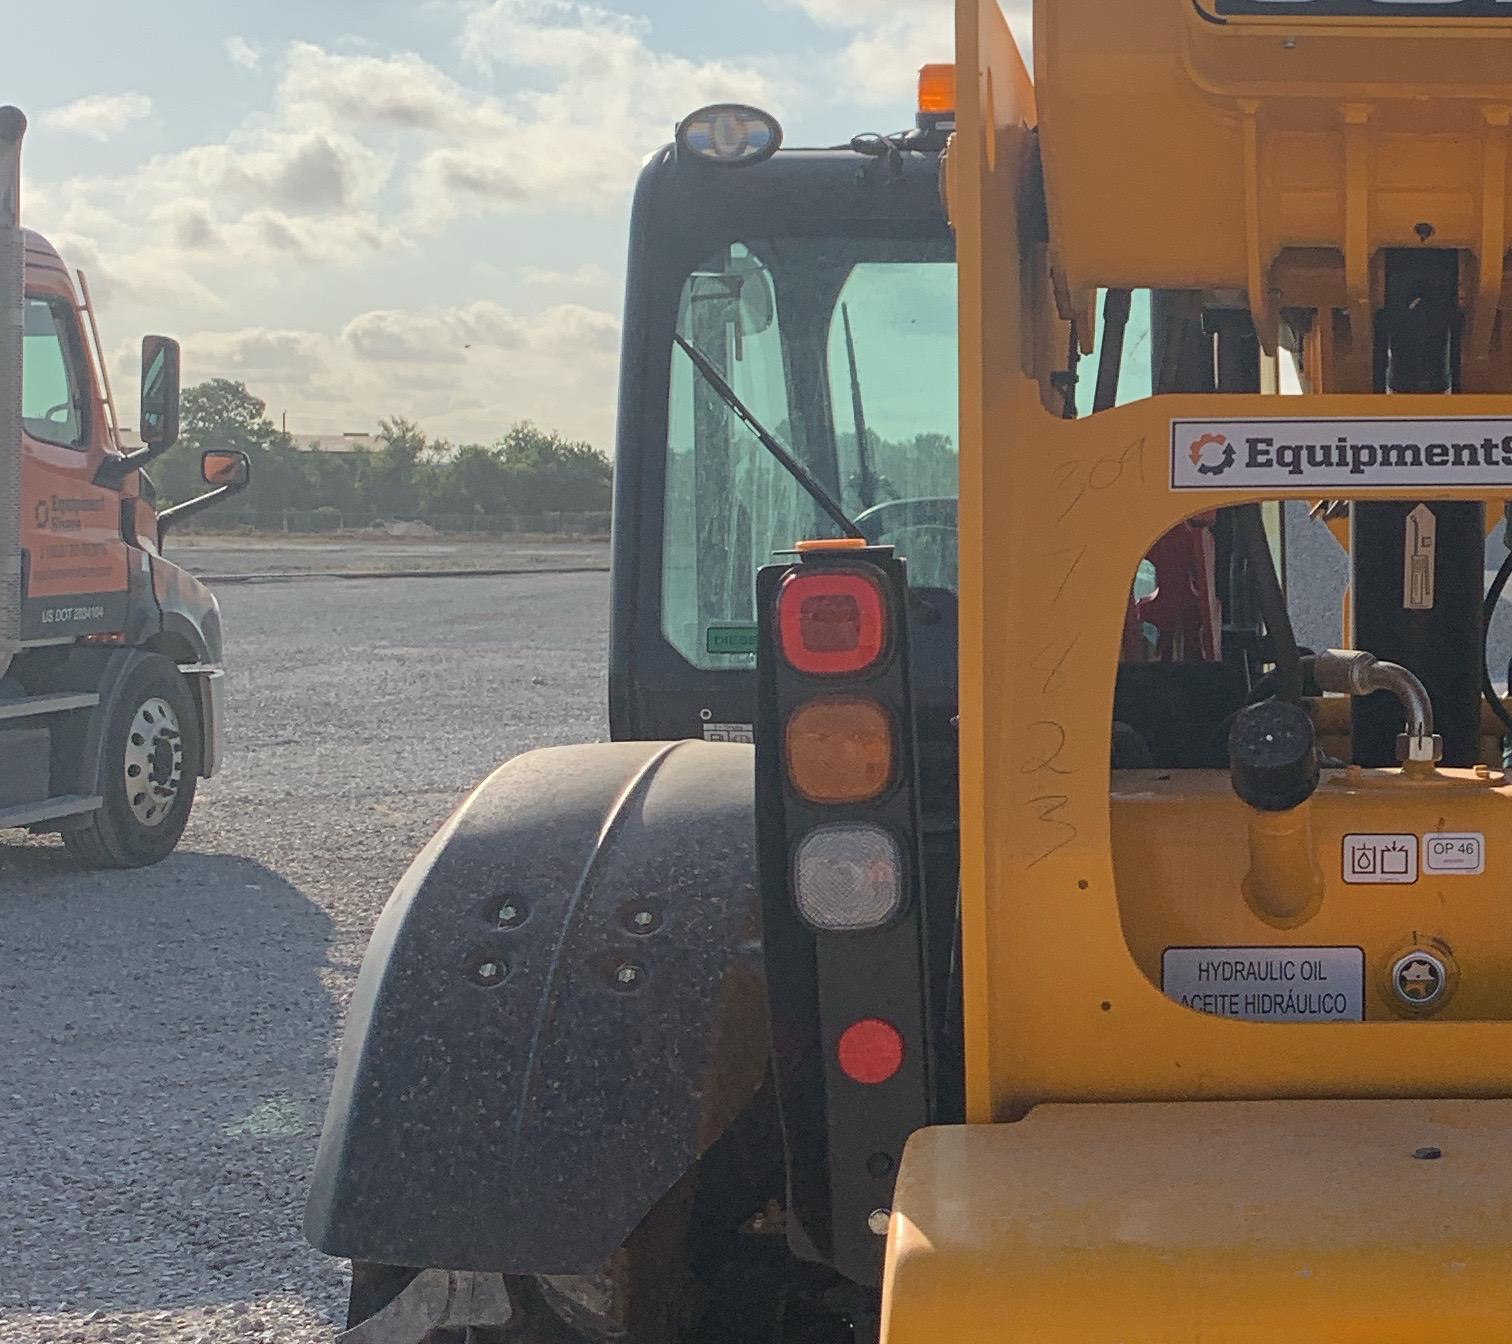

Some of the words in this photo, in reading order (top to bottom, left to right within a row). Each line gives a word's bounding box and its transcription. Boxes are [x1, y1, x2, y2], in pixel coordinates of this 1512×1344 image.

[1433, 842, 1454, 855] OP
[1457, 842, 1474, 855] 46
[1198, 960, 1296, 982] HYDRAULIC
[1300, 960, 1328, 982] OIL
[1244, 988, 1348, 1015] HIDRÁULICO
